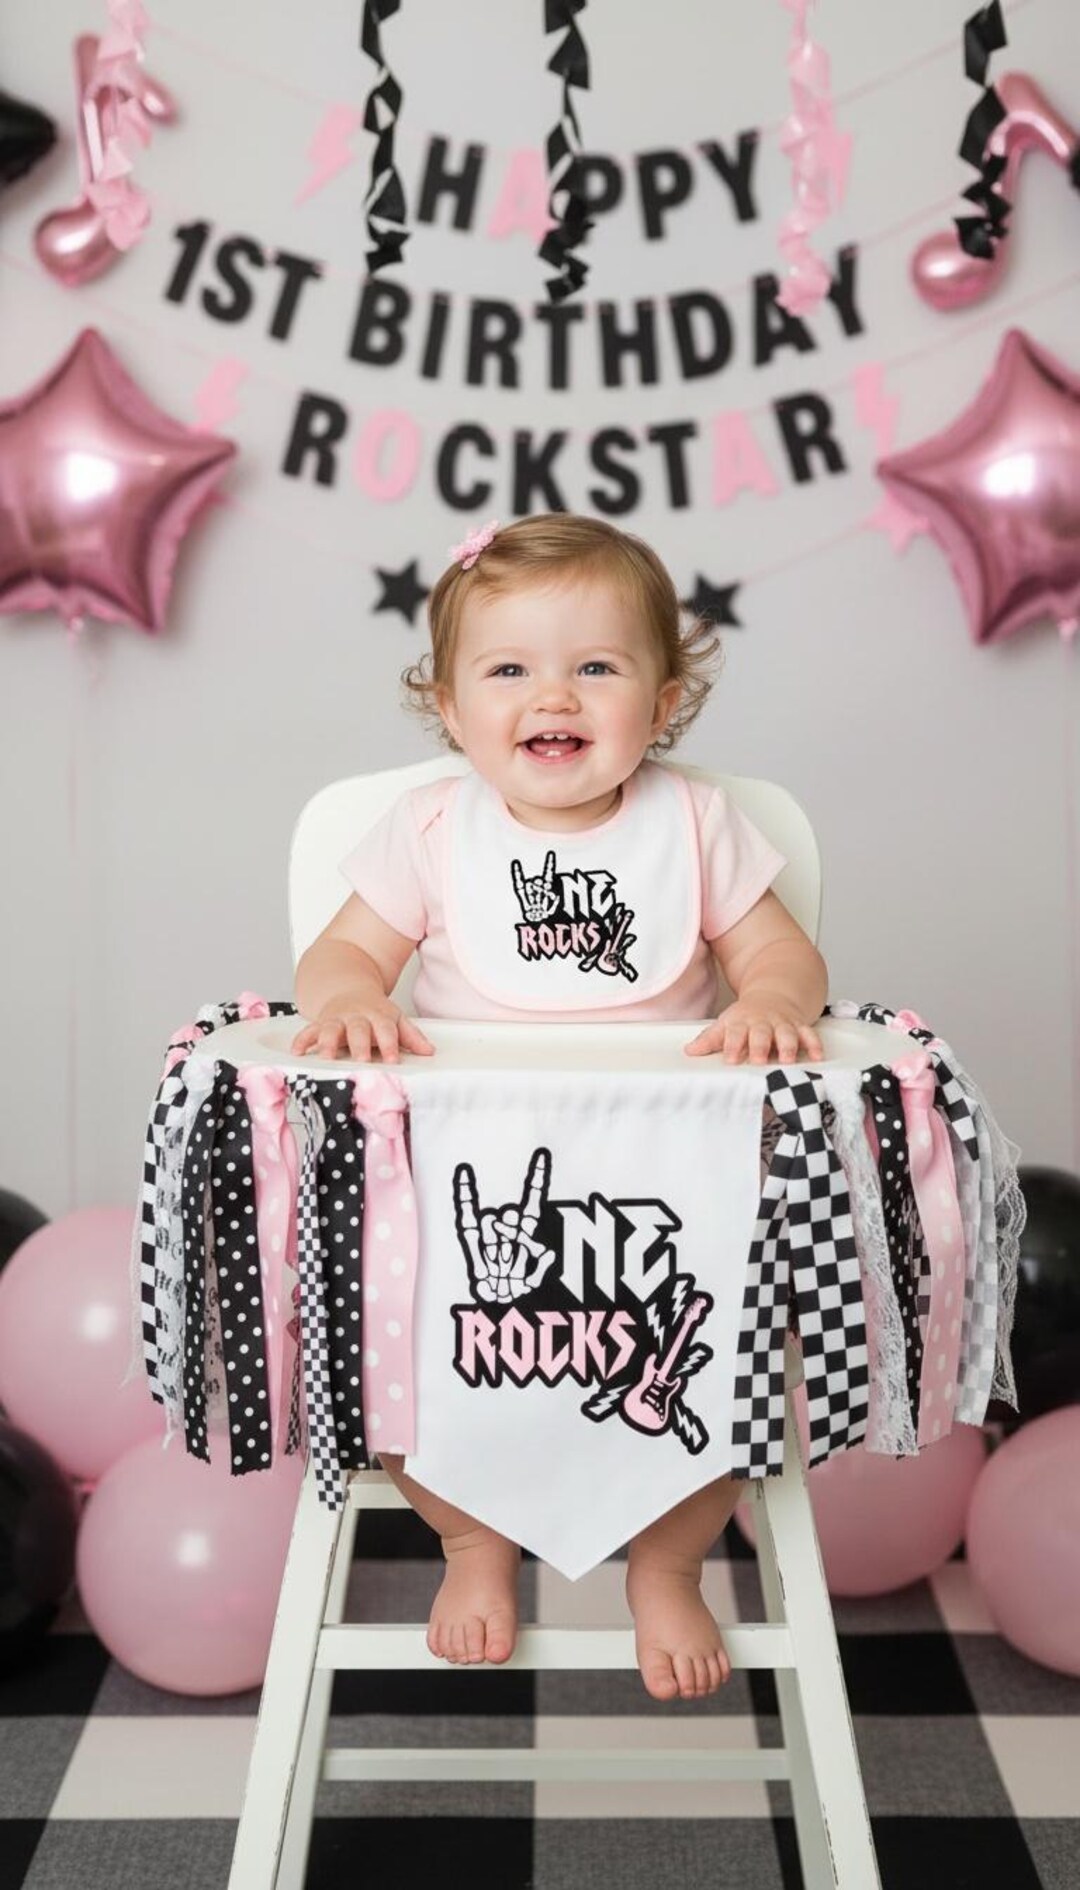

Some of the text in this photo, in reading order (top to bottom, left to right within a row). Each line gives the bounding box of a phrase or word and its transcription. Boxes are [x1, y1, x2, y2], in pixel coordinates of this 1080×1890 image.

[416, 128, 762, 242] HAPPY
[163, 219, 867, 392] 1ST BIRTHDAY
[281, 390, 850, 518] ROCKSTAR
[518, 921, 602, 958] ROCKS
[455, 1305, 638, 1382] ROCKS
